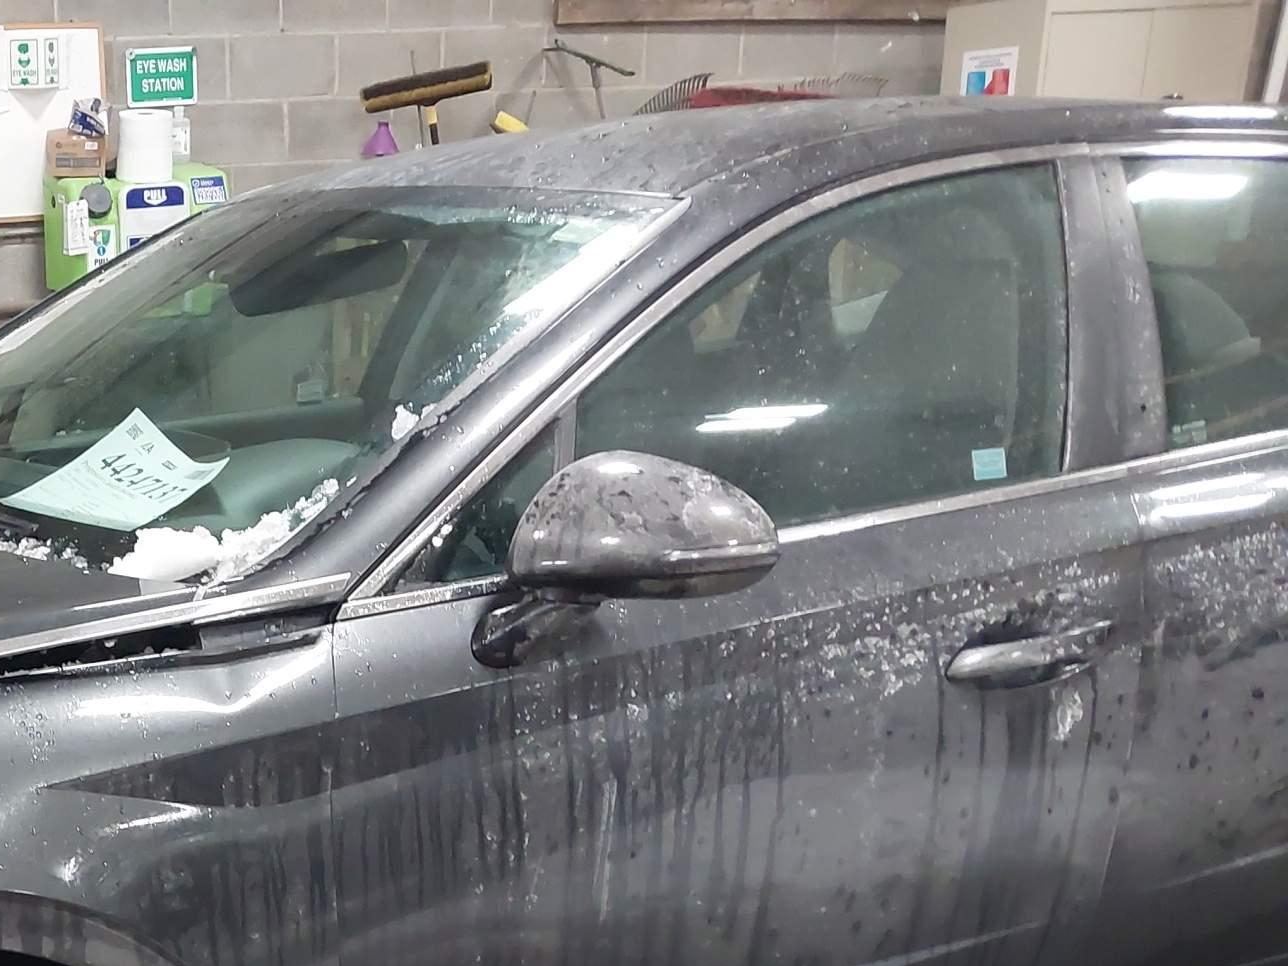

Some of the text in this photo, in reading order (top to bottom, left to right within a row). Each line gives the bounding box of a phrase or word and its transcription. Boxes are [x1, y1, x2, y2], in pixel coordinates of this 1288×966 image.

[136, 58, 187, 74] EYE WASH
[142, 77, 185, 93] STATION
[143, 189, 167, 201] PULL
